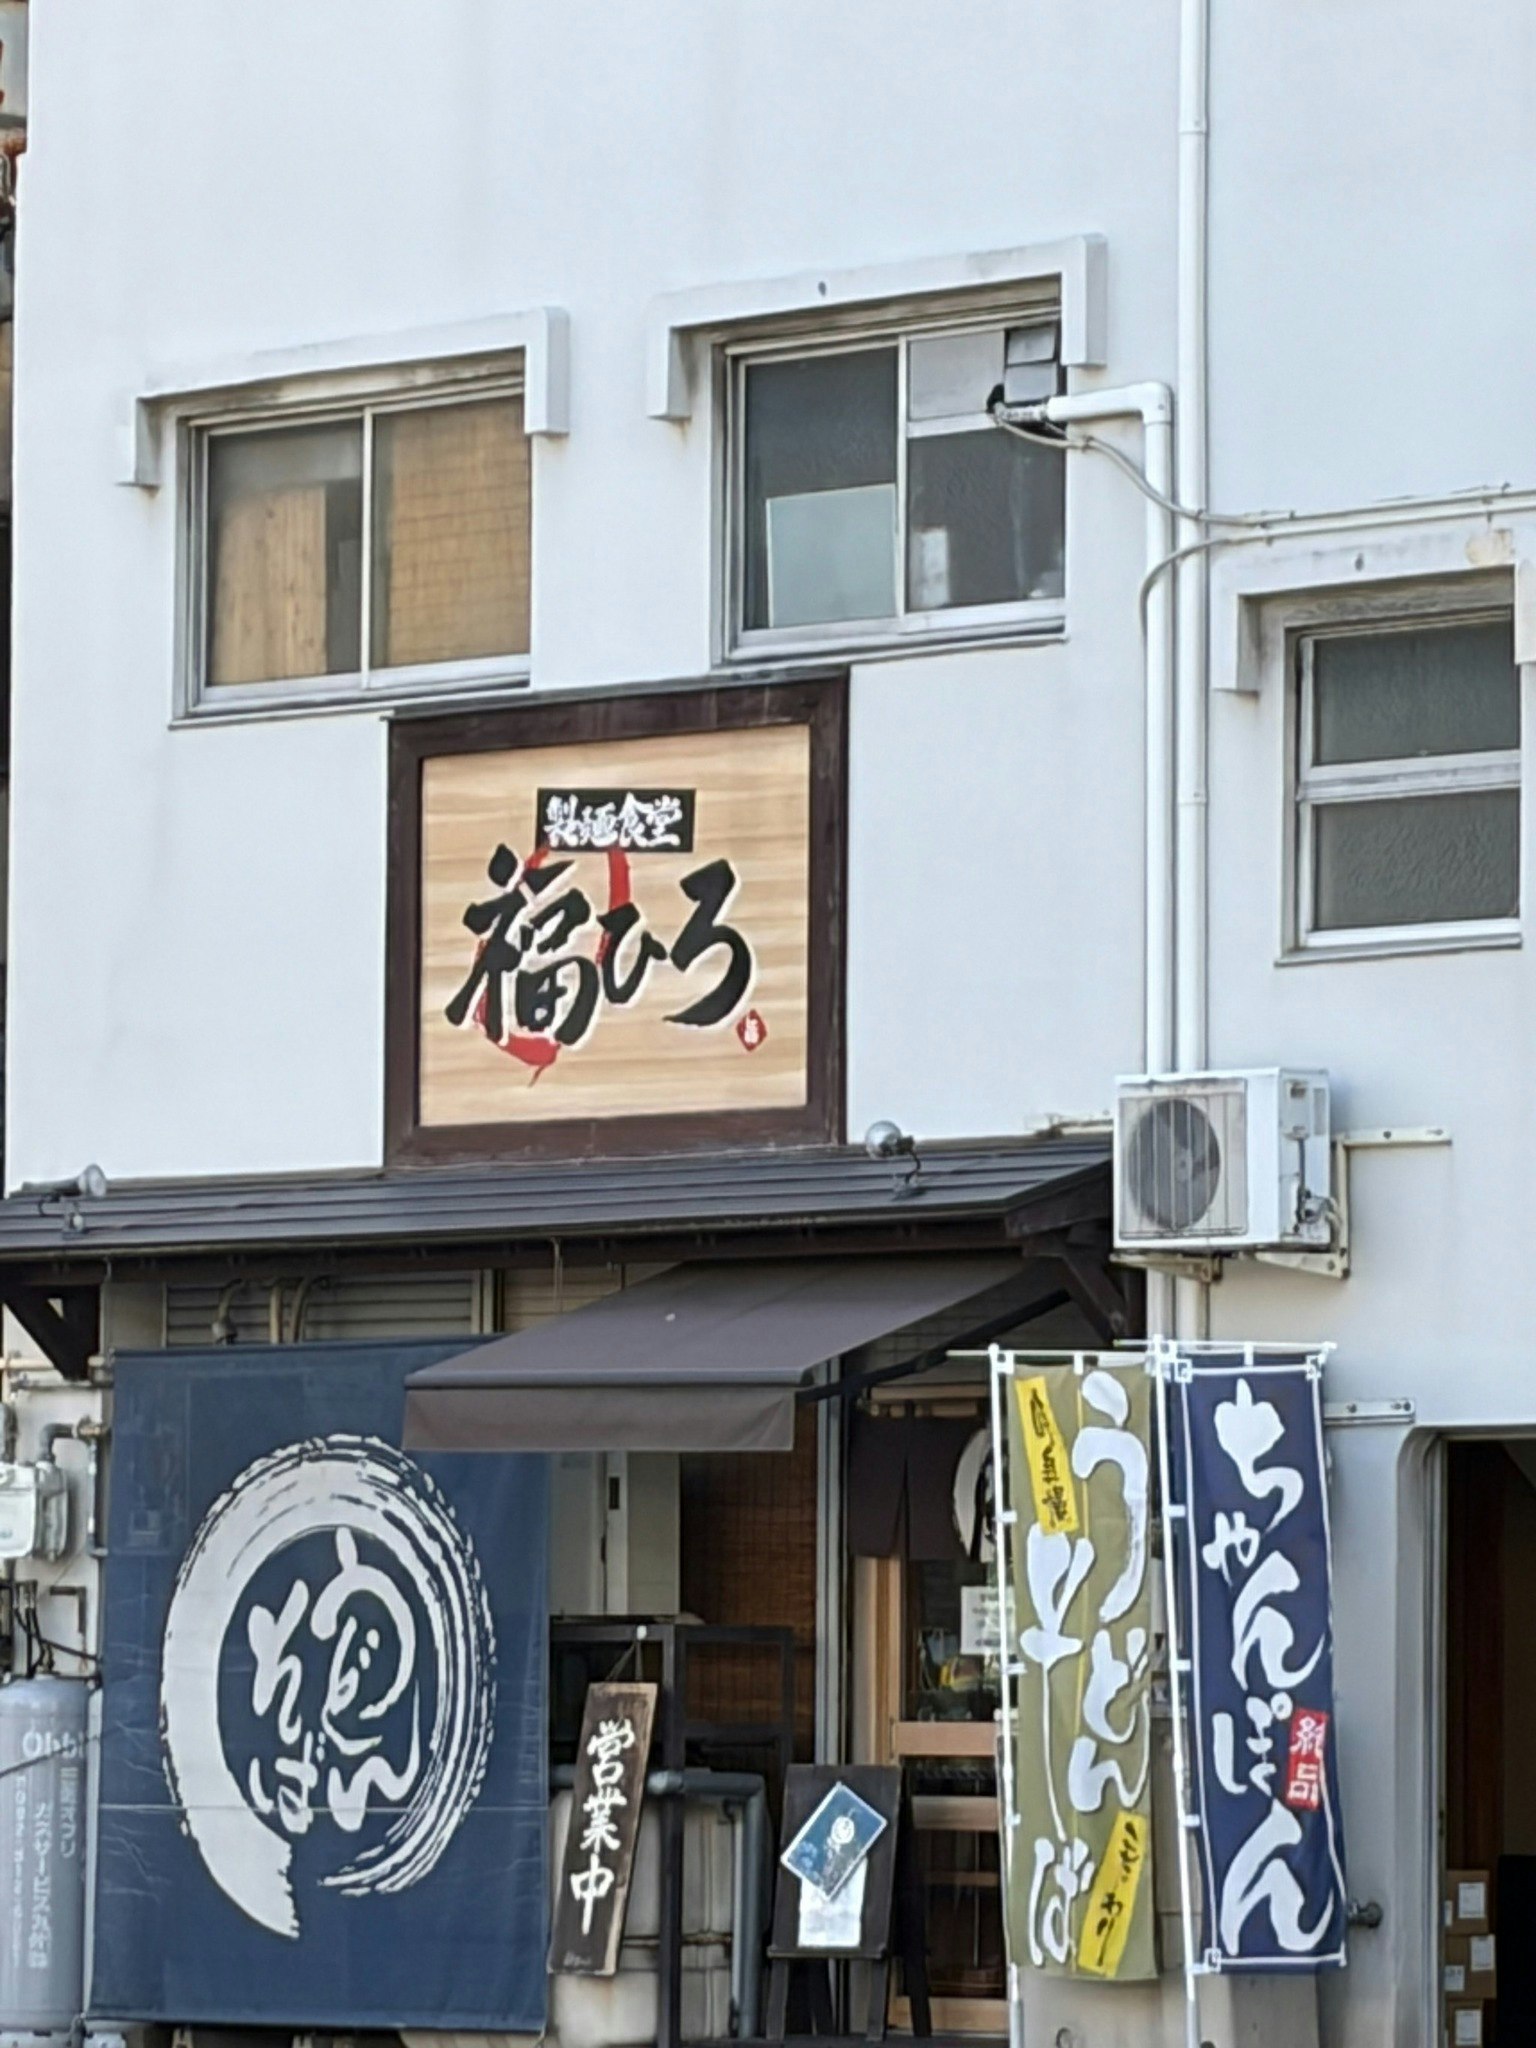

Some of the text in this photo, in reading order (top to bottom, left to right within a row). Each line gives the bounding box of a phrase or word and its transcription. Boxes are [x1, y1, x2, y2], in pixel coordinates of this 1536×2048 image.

[446, 843, 752, 1046] 福ひろ
[1020, 1523, 1095, 1967] そば
[1068, 1371, 1149, 1811] うどん
[1203, 1378, 1334, 1956] ちゃんぽん
[570, 1718, 636, 1935] 営業中
